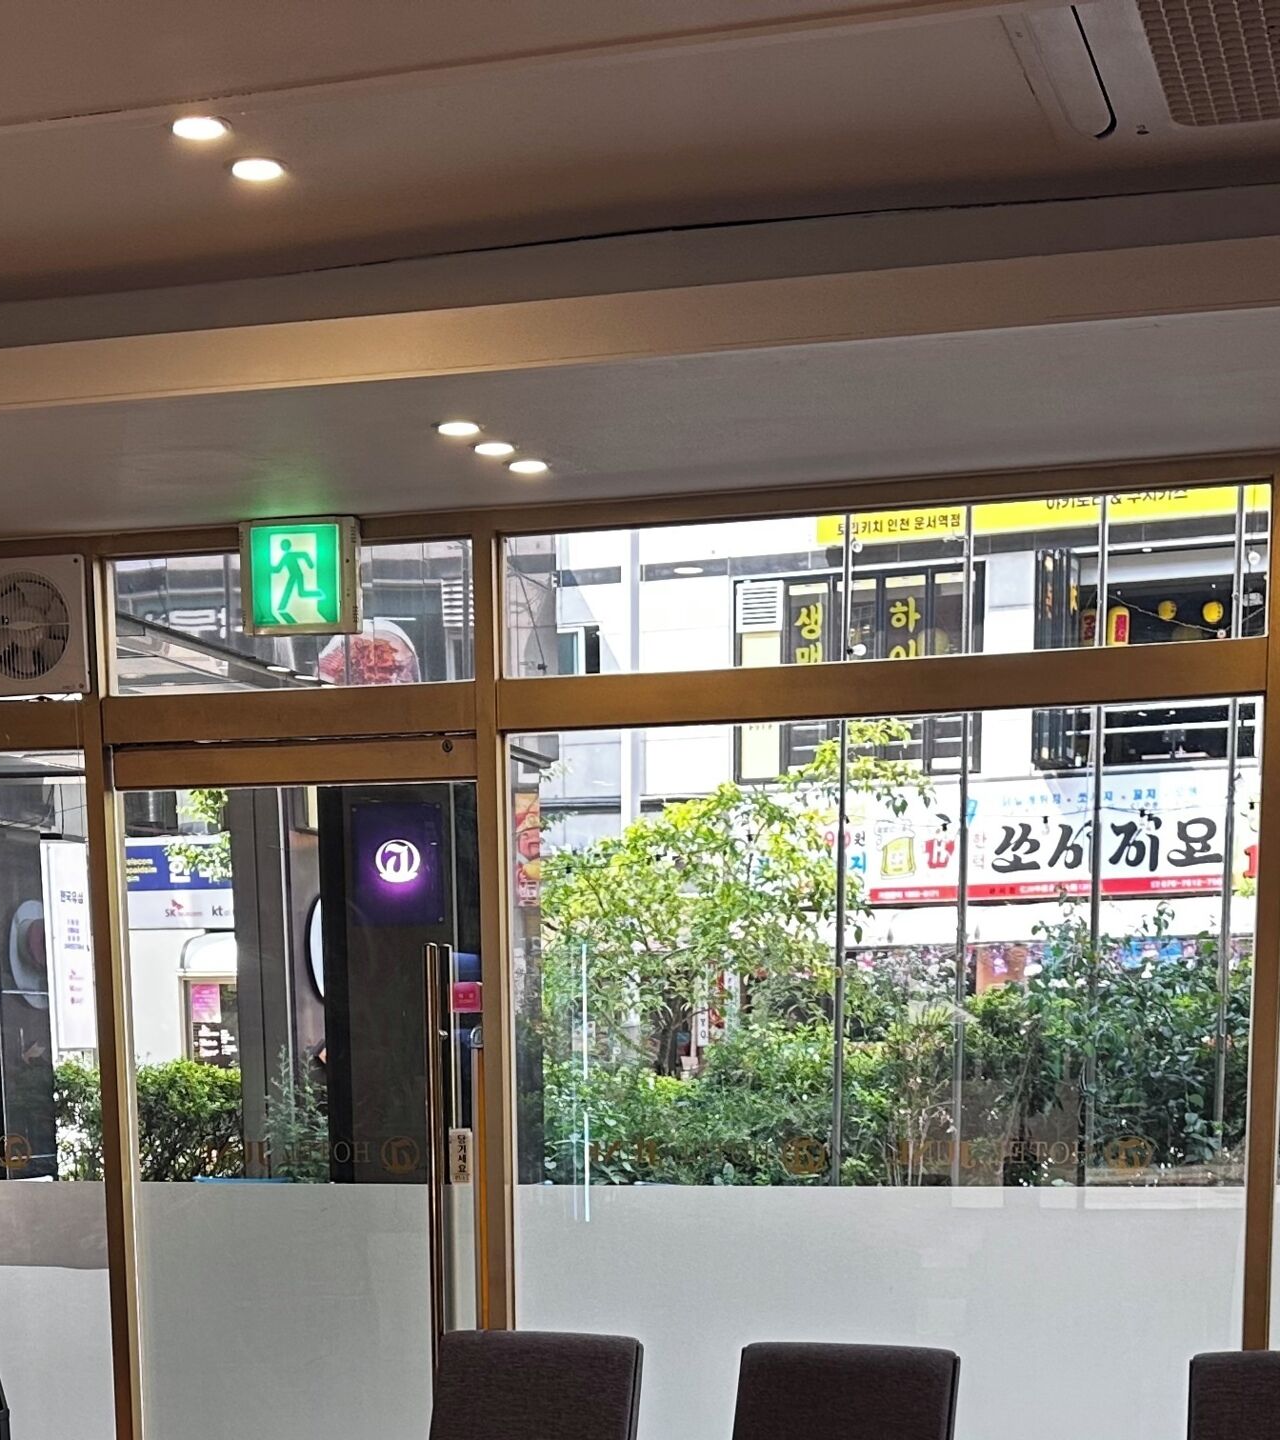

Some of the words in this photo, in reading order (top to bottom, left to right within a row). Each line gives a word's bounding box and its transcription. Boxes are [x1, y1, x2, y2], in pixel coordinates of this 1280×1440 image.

[888, 518, 910, 532] 인천
[914, 513, 961, 530] 운서역점
[457, 1134, 467, 1173] 당기세요
